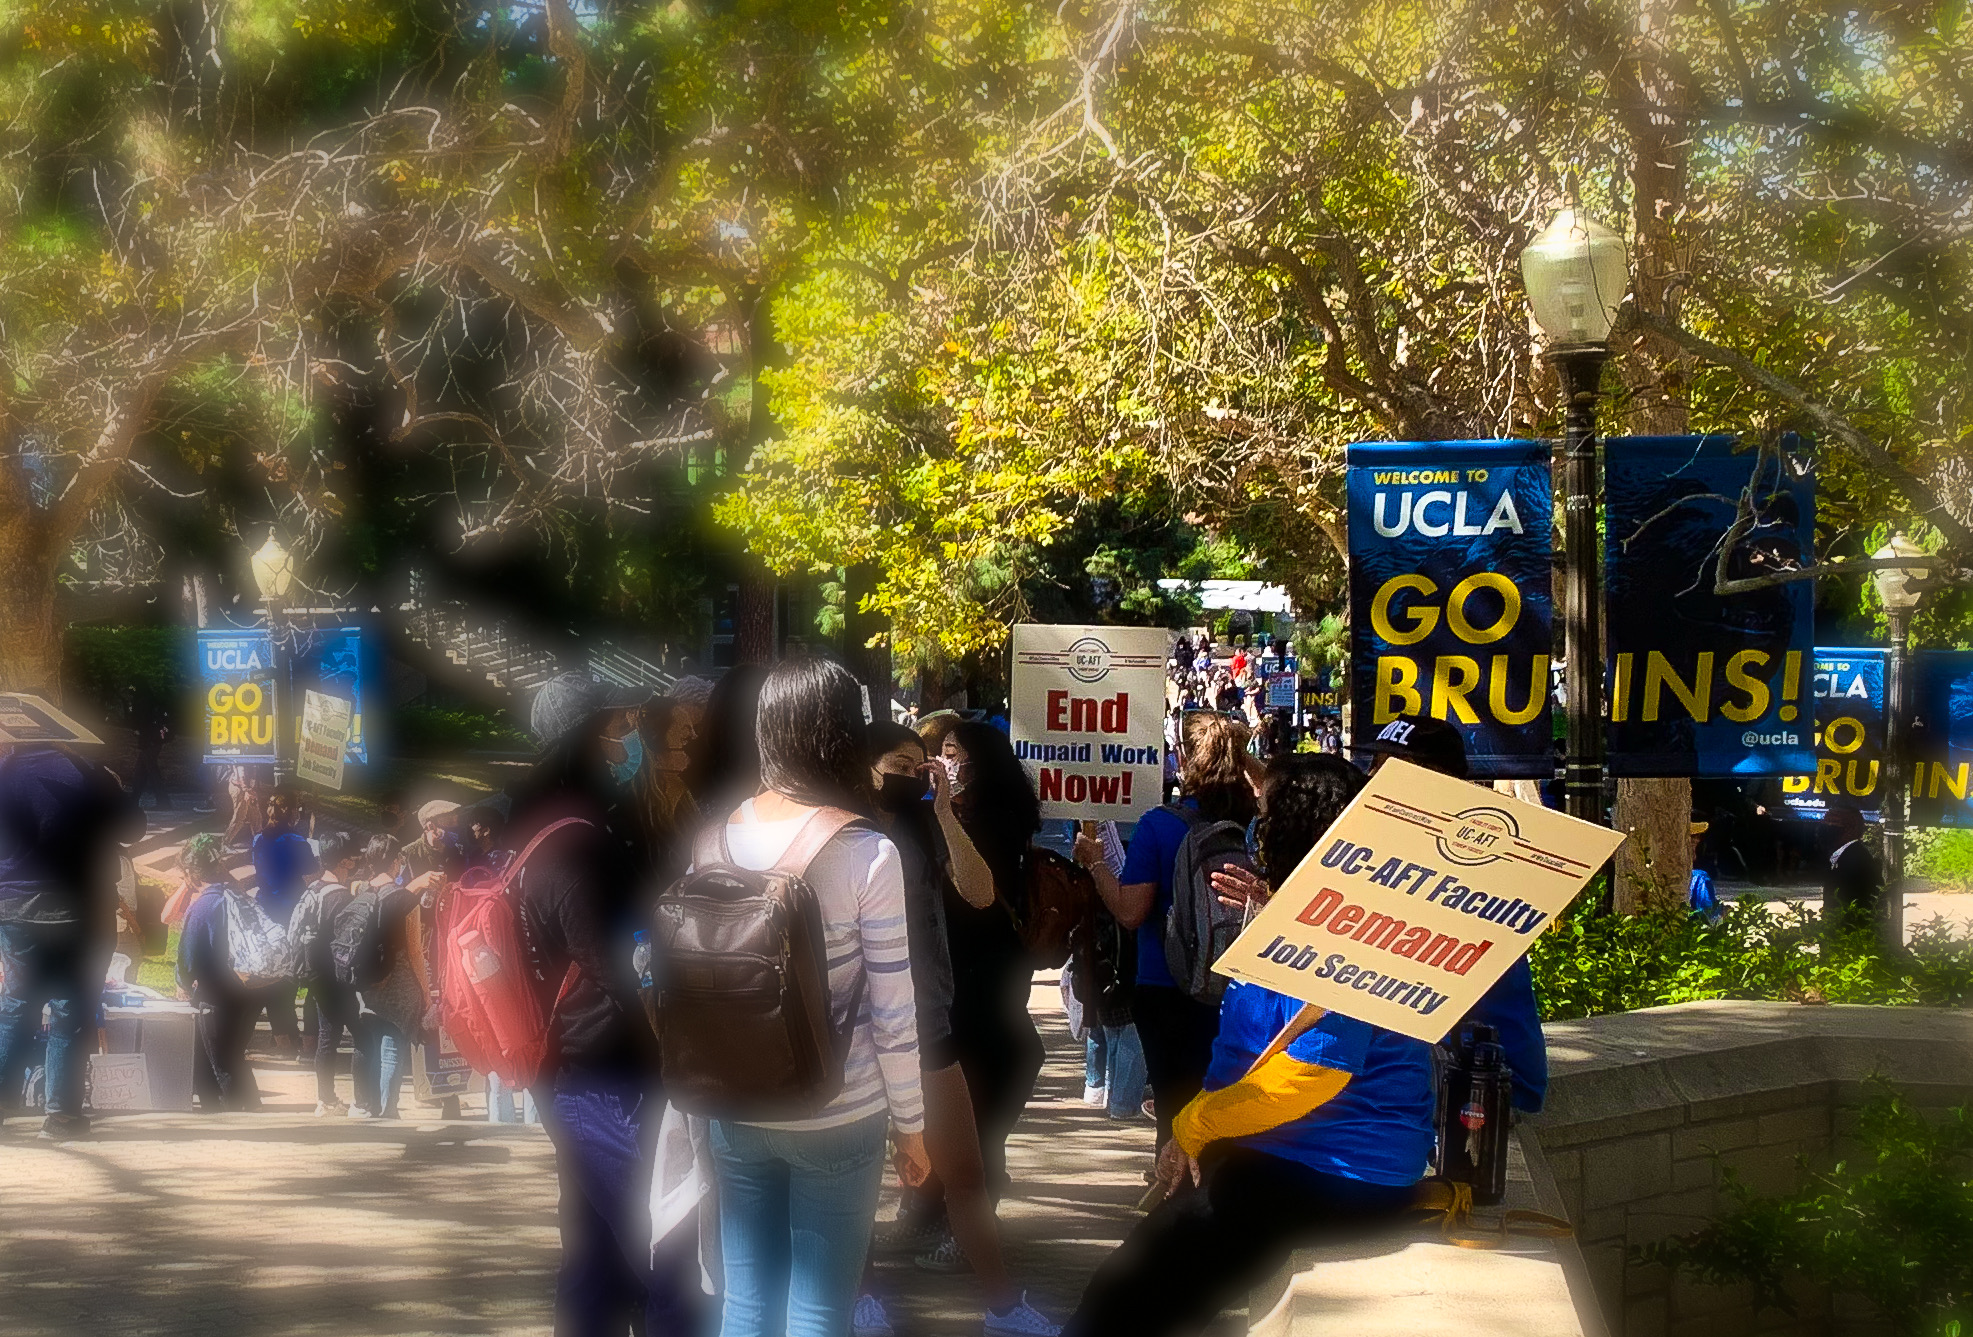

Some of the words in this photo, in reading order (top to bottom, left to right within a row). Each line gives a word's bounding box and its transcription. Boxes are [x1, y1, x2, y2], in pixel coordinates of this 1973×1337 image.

[1374, 470, 1460, 485] WELCOME
[1466, 468, 1489, 483] TO
[1373, 488, 1524, 538] UCLA
[1370, 572, 1522, 645] GO
[207, 649, 262, 670] UCLA
[1076, 655, 1102, 666] UC-AFT
[1264, 662, 1292, 673] UCA
[207, 682, 263, 713] GO
[1373, 654, 1549, 725] BRU
[1611, 649, 1802, 722] INS!
[1813, 673, 1868, 699] CLA
[1046, 690, 1129, 734] End
[209, 714, 274, 745] BRU
[1741, 730, 1799, 748] @ucla
[1814, 716, 1866, 755] O
[1015, 740, 1091, 763] Unpaid
[1101, 743, 1159, 765] Work
[1040, 767, 1133, 805] Now!
[1456, 826, 1500, 848] UC-AFT
[1319, 838, 1437, 896] UC-AFT
[1425, 874, 1548, 935] Faculty
[1294, 887, 1495, 977] Demand
[1257, 934, 1319, 972] Job
[1314, 953, 1451, 1016] Security
